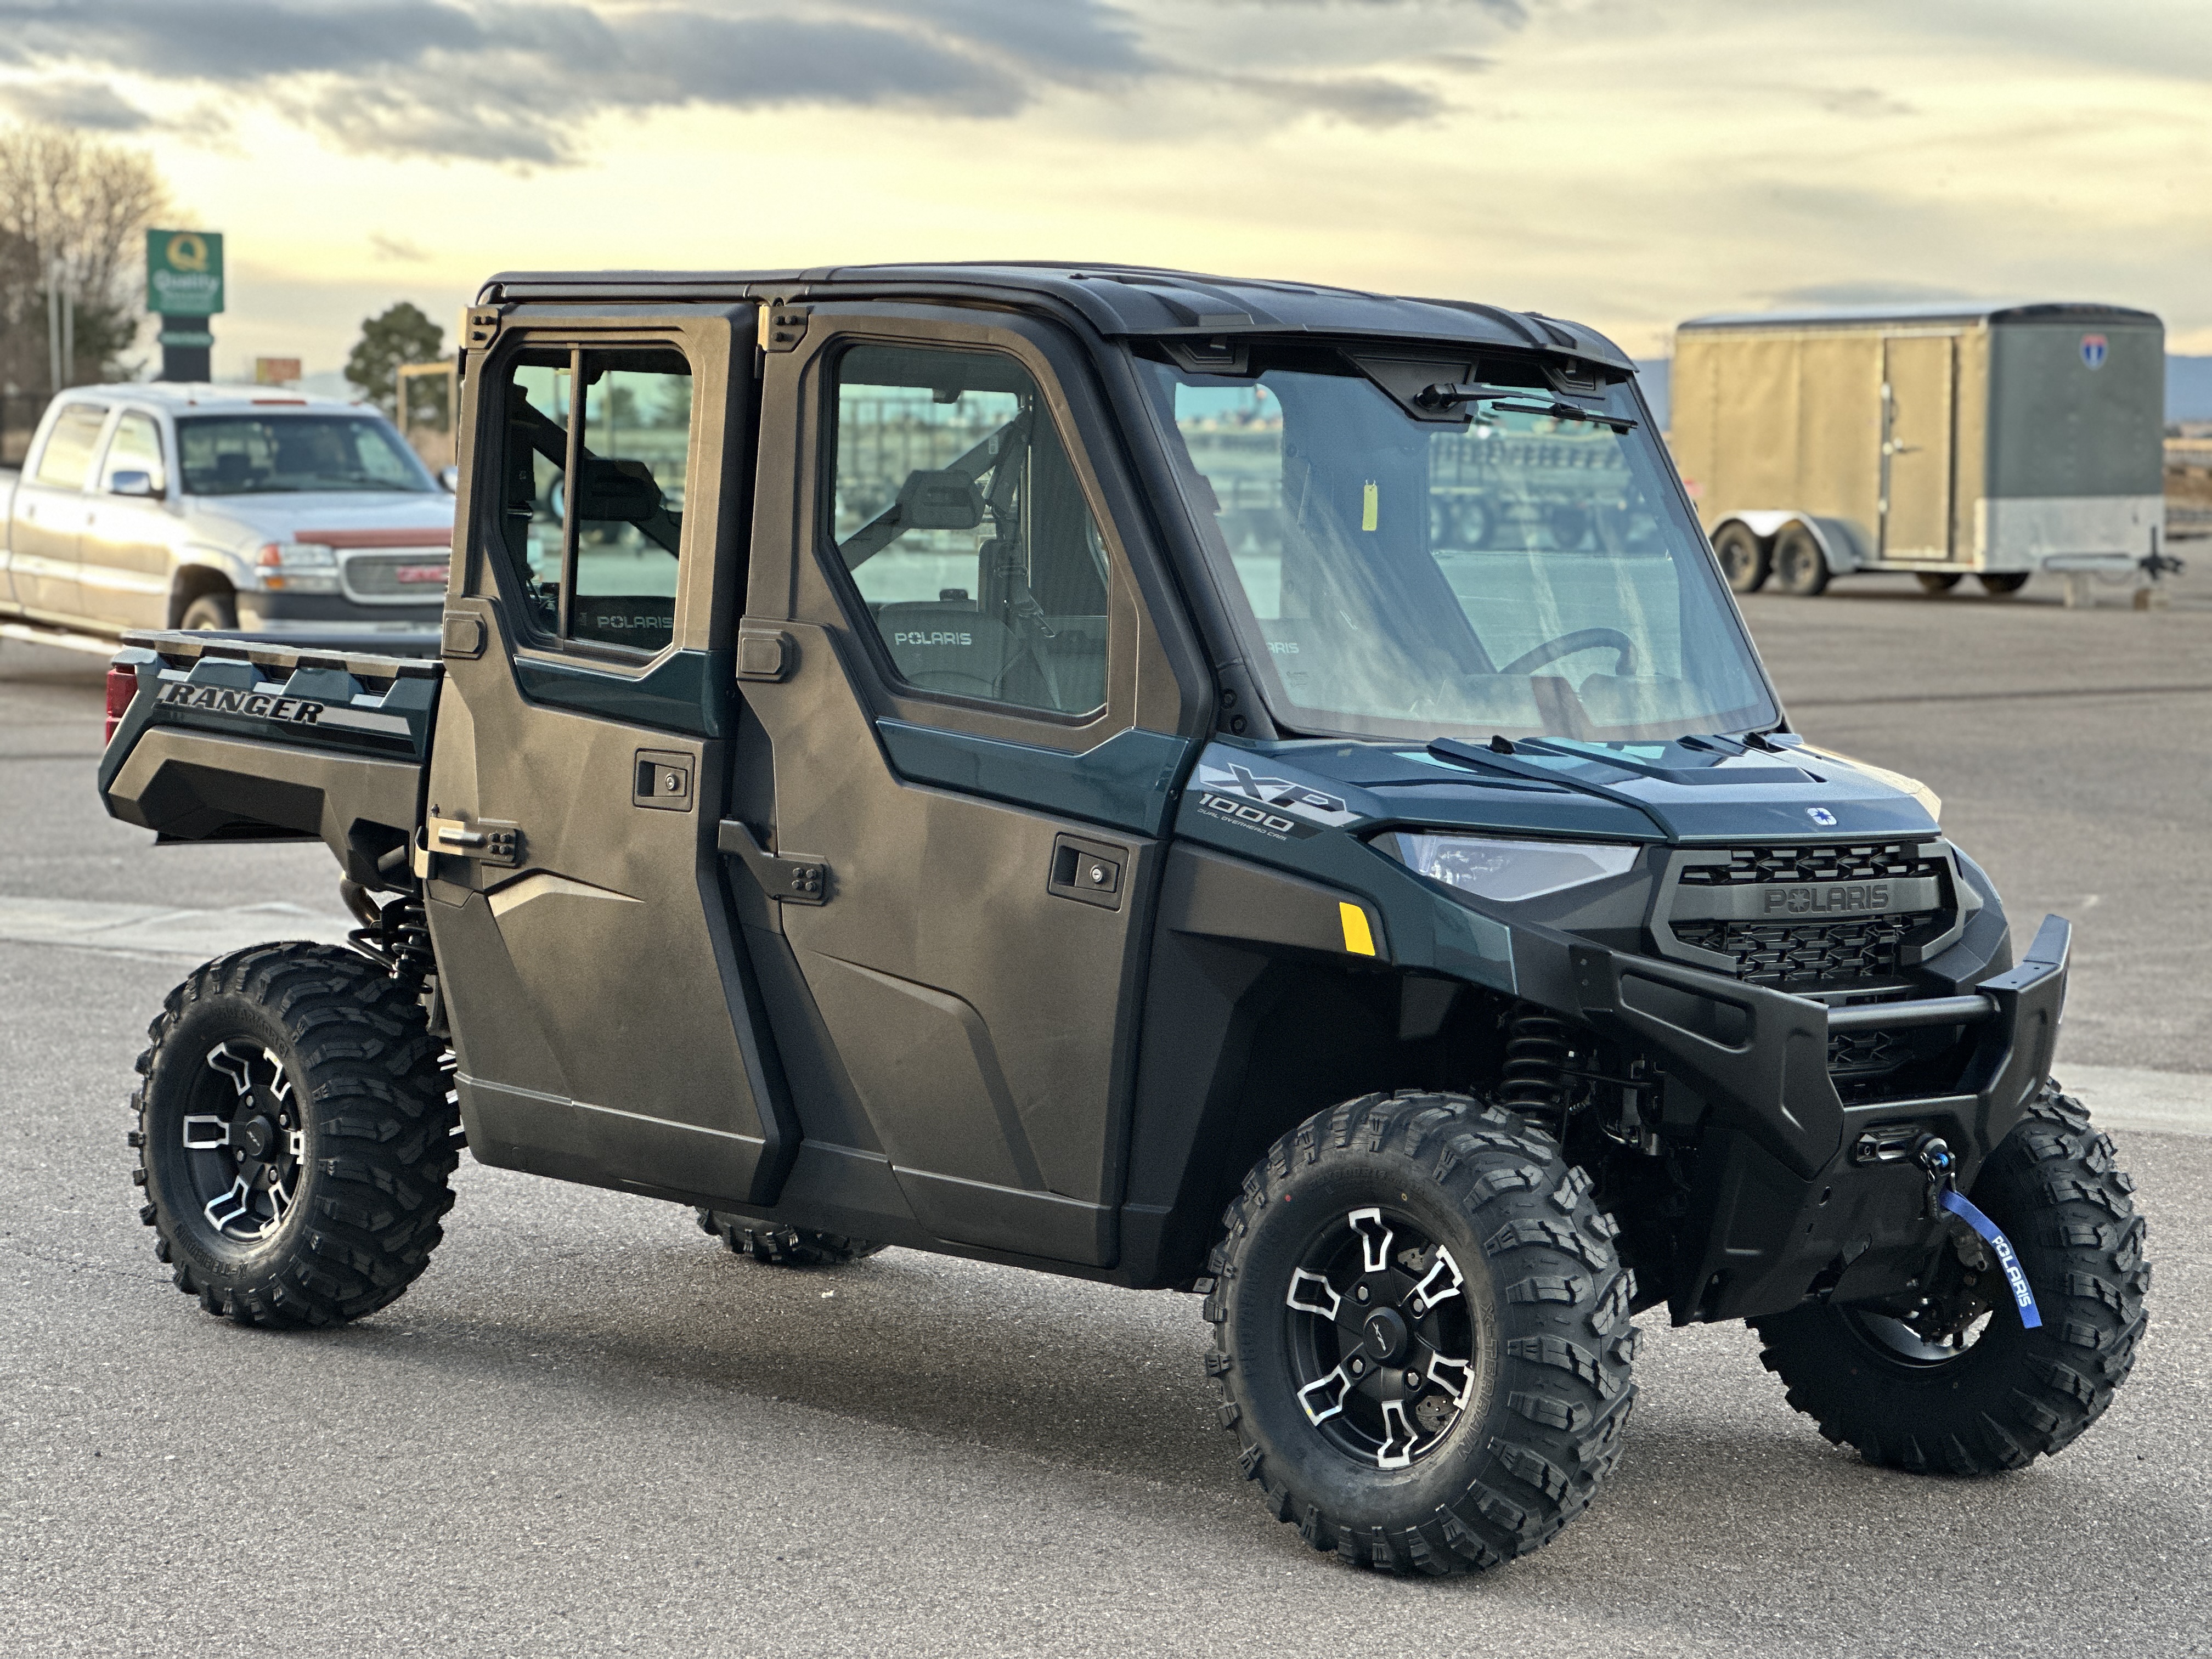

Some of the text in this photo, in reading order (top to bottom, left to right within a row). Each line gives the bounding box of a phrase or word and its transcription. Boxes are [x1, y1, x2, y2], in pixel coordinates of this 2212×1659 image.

[596, 616, 673, 628] POLARIS
[894, 631, 972, 646] POLARIS
[1266, 641, 1300, 654] ARIS
[164, 682, 325, 725] RANGER
[1200, 763, 1347, 811] XP
[1197, 808, 1288, 841] DUAL OVERHEAD CAM
[1199, 793, 1294, 832] 1000
[1764, 884, 1889, 914] POLARIS
[1991, 1235, 2032, 1308] POLARIS
[1457, 1302, 1498, 1462] X-TERRAIN
